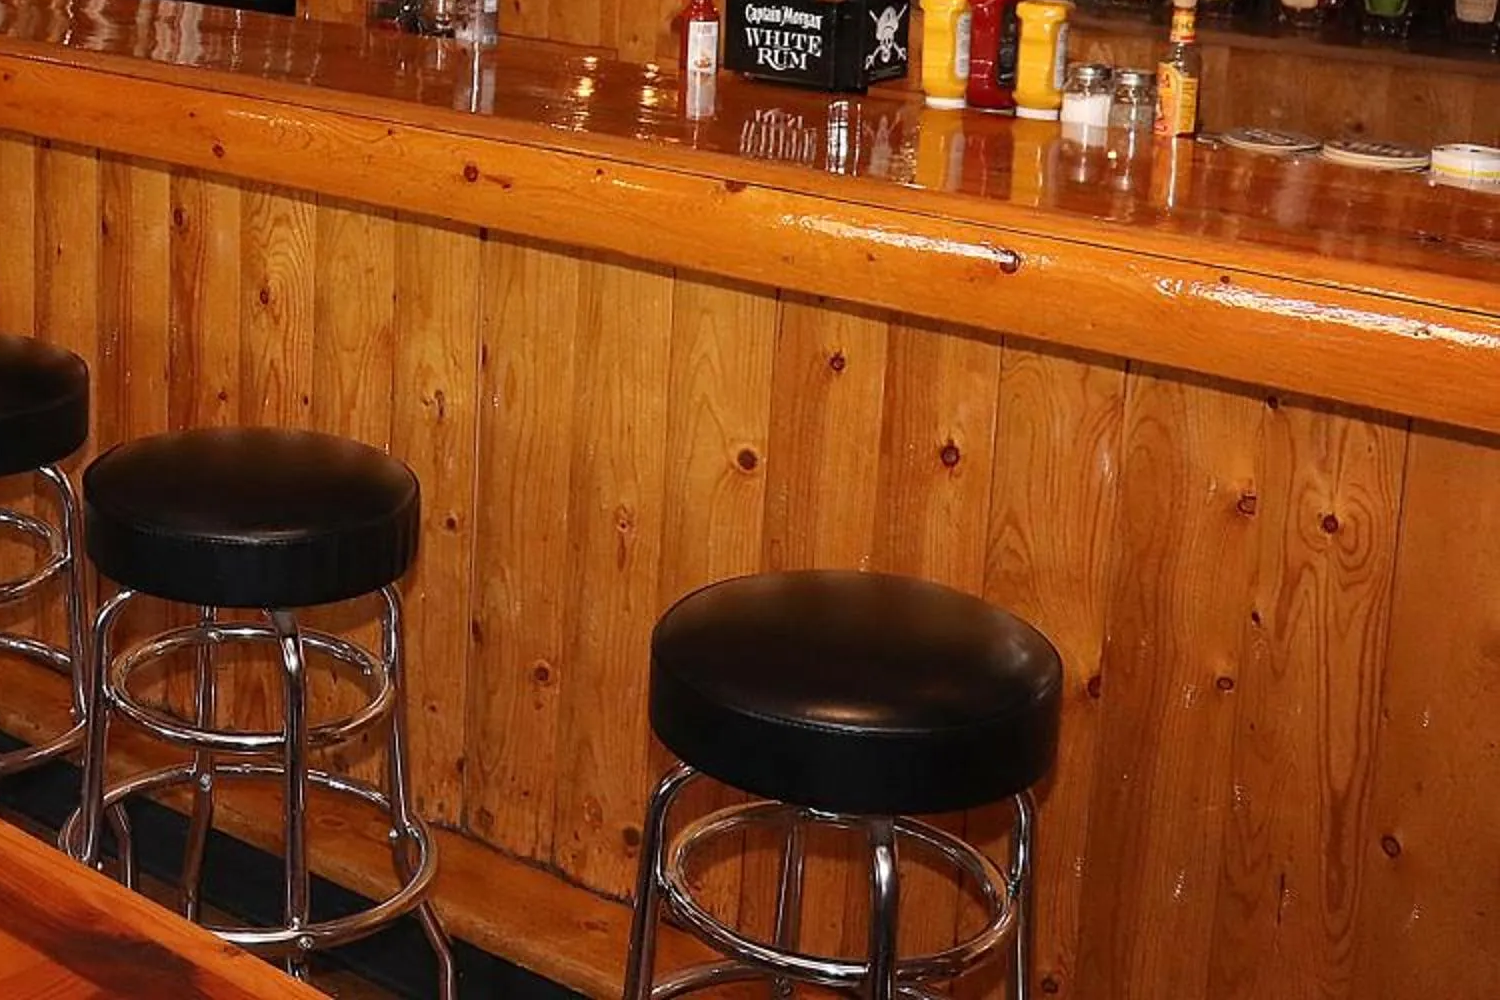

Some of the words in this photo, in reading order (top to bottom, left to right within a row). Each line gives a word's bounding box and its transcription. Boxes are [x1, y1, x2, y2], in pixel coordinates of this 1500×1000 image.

[745, 3, 781, 25] Captain
[780, 5, 824, 30] Morgan
[744, 27, 823, 58] WHITE
[756, 47, 807, 71] RUM
